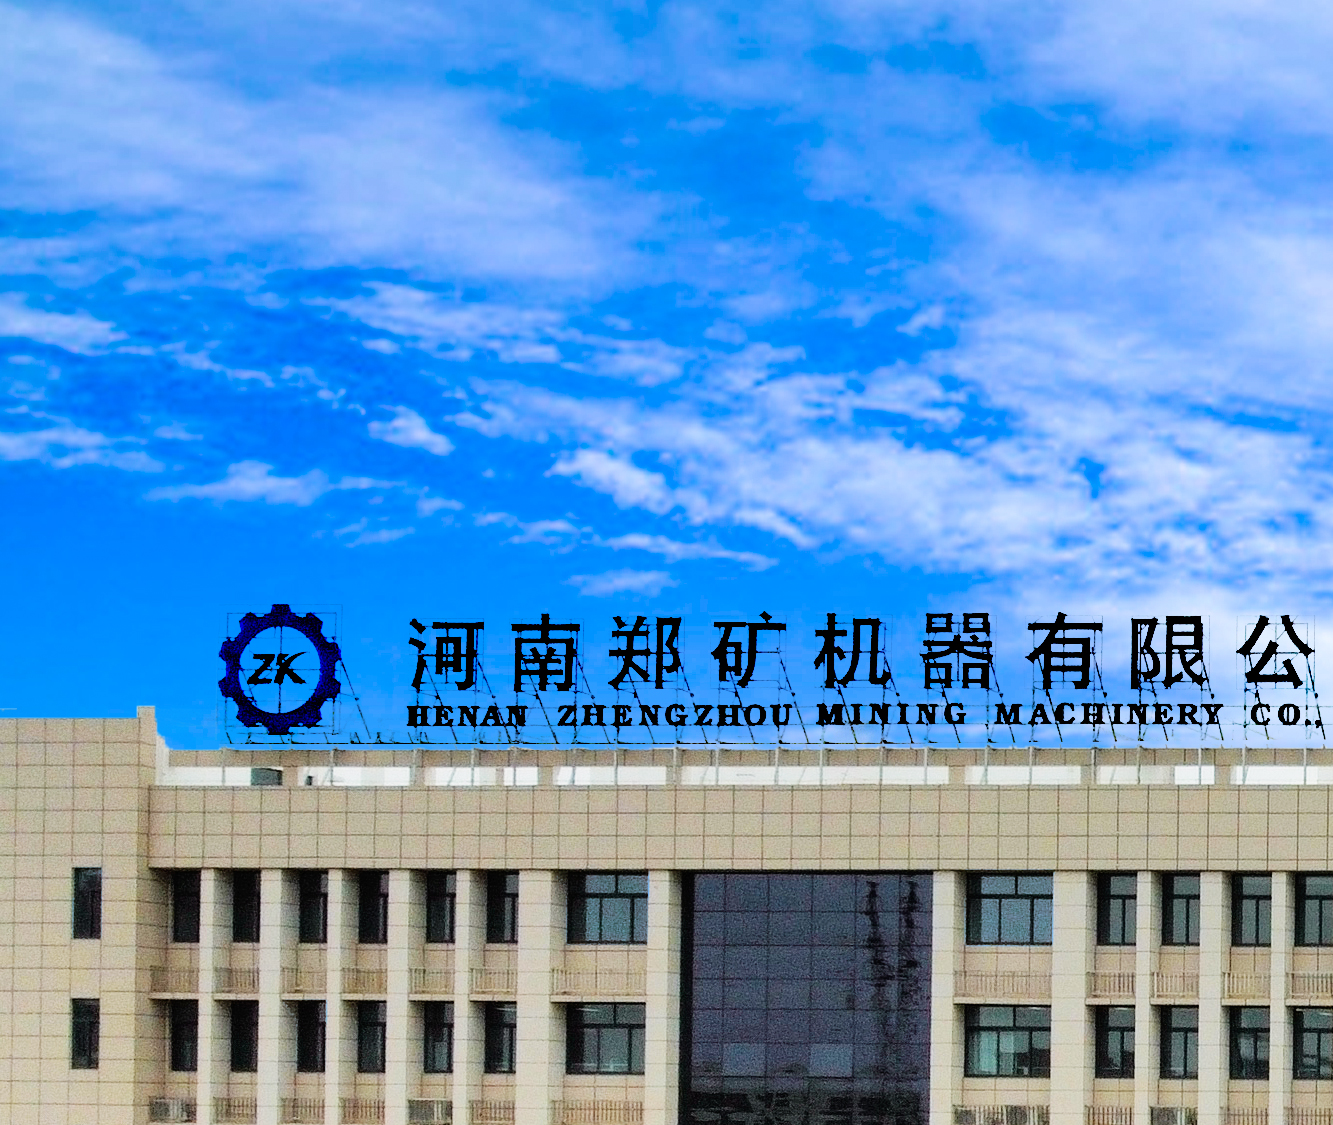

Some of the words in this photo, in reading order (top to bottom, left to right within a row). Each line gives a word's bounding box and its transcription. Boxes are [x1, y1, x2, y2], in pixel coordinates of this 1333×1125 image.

[246, 650, 306, 686] ZK
[406, 704, 528, 727] HENAN
[557, 703, 792, 727] ZHENGZHOU
[815, 702, 967, 726] MINING
[994, 702, 1224, 726] MACHINERY
[1250, 702, 1323, 729] CO.,
